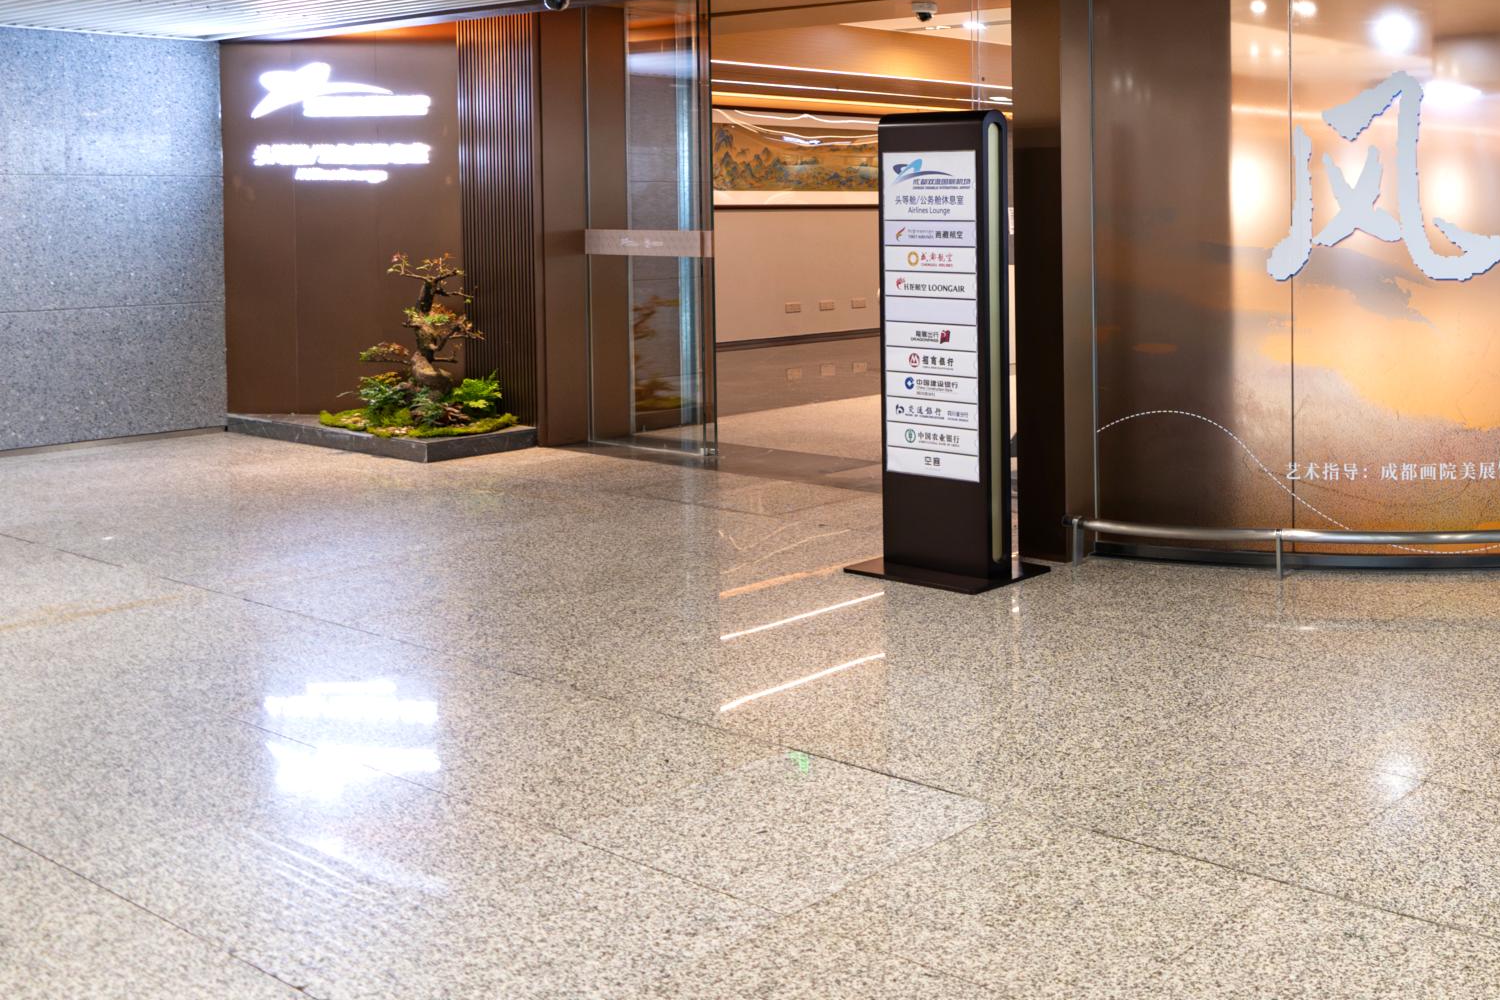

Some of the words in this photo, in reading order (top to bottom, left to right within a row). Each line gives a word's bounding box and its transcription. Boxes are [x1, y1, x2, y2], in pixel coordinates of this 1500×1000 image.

[895, 195, 964, 206] 头等舱/公务舱休息室
[929, 207, 950, 216] Lounge
[928, 282, 965, 292] LOONGAIR
[916, 378, 958, 389] 中国建设银行
[917, 431, 960, 444] 中国农业银行
